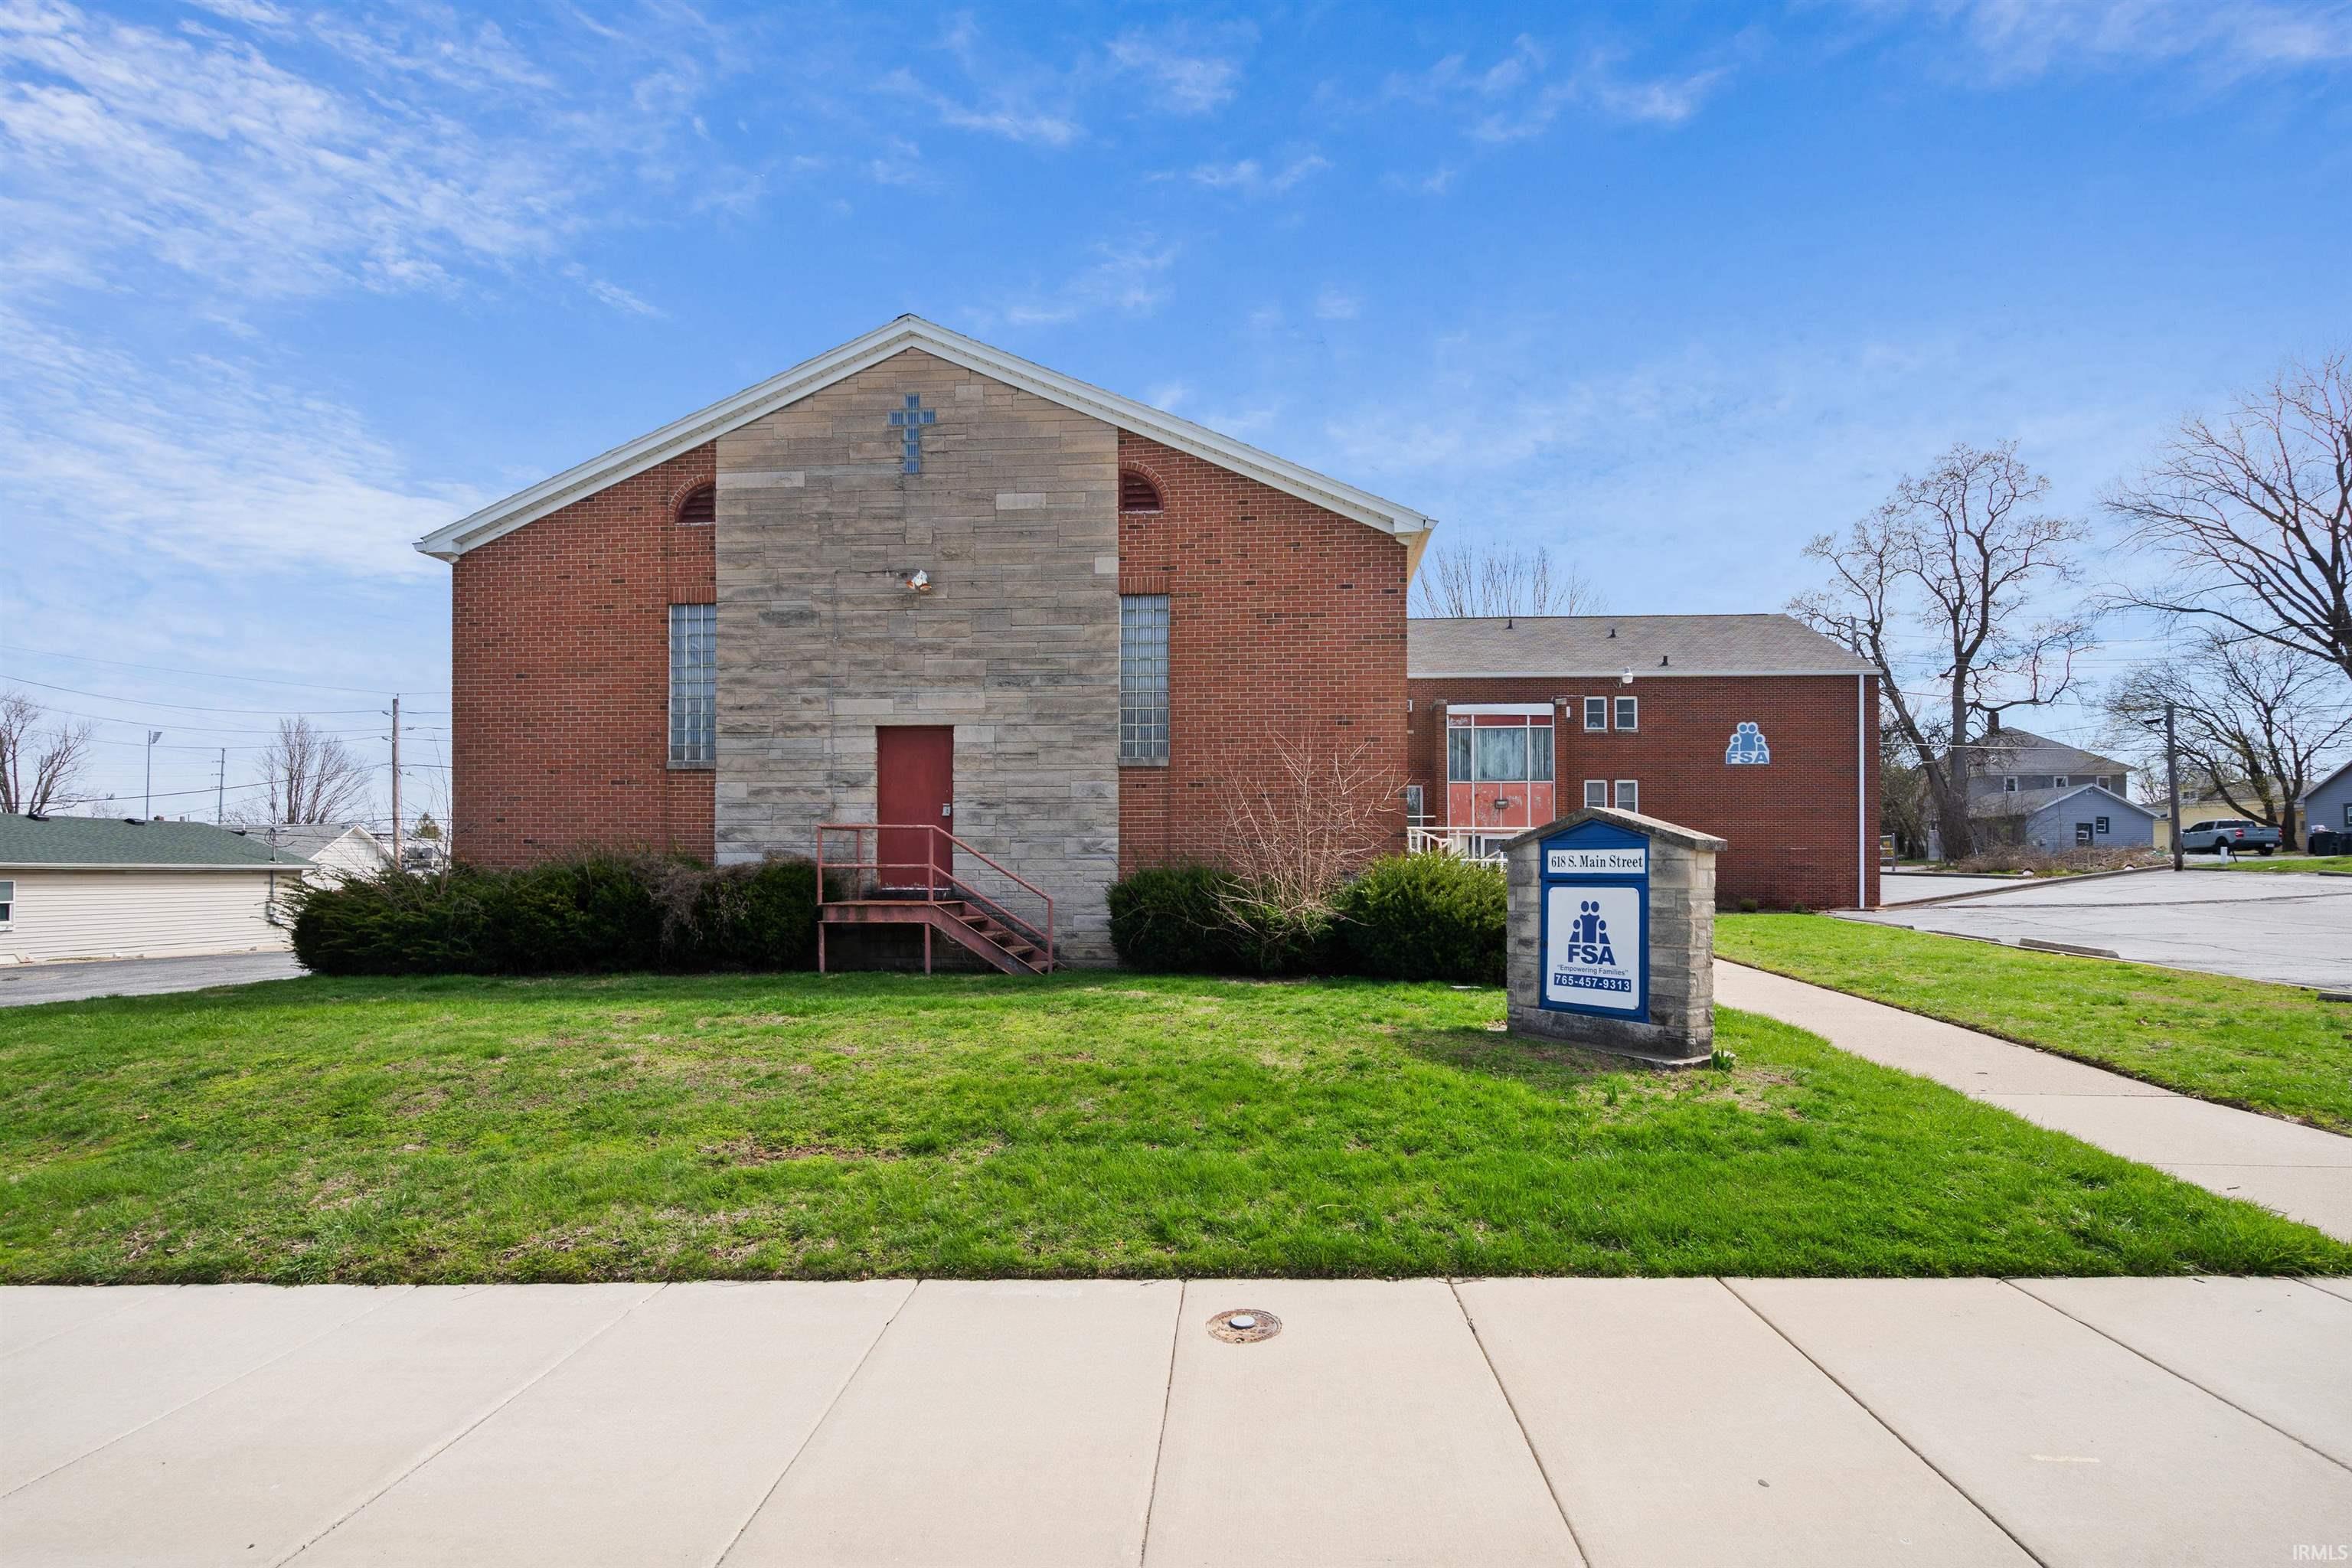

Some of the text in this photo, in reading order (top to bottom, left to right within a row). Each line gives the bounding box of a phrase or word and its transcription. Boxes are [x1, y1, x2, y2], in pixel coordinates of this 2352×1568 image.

[1726, 752, 1769, 763] FSA
[1551, 854, 1643, 867] 618 S. Main Street
[1567, 943, 1616, 965] FSA
[1555, 975, 1630, 991] 765-457-9313
